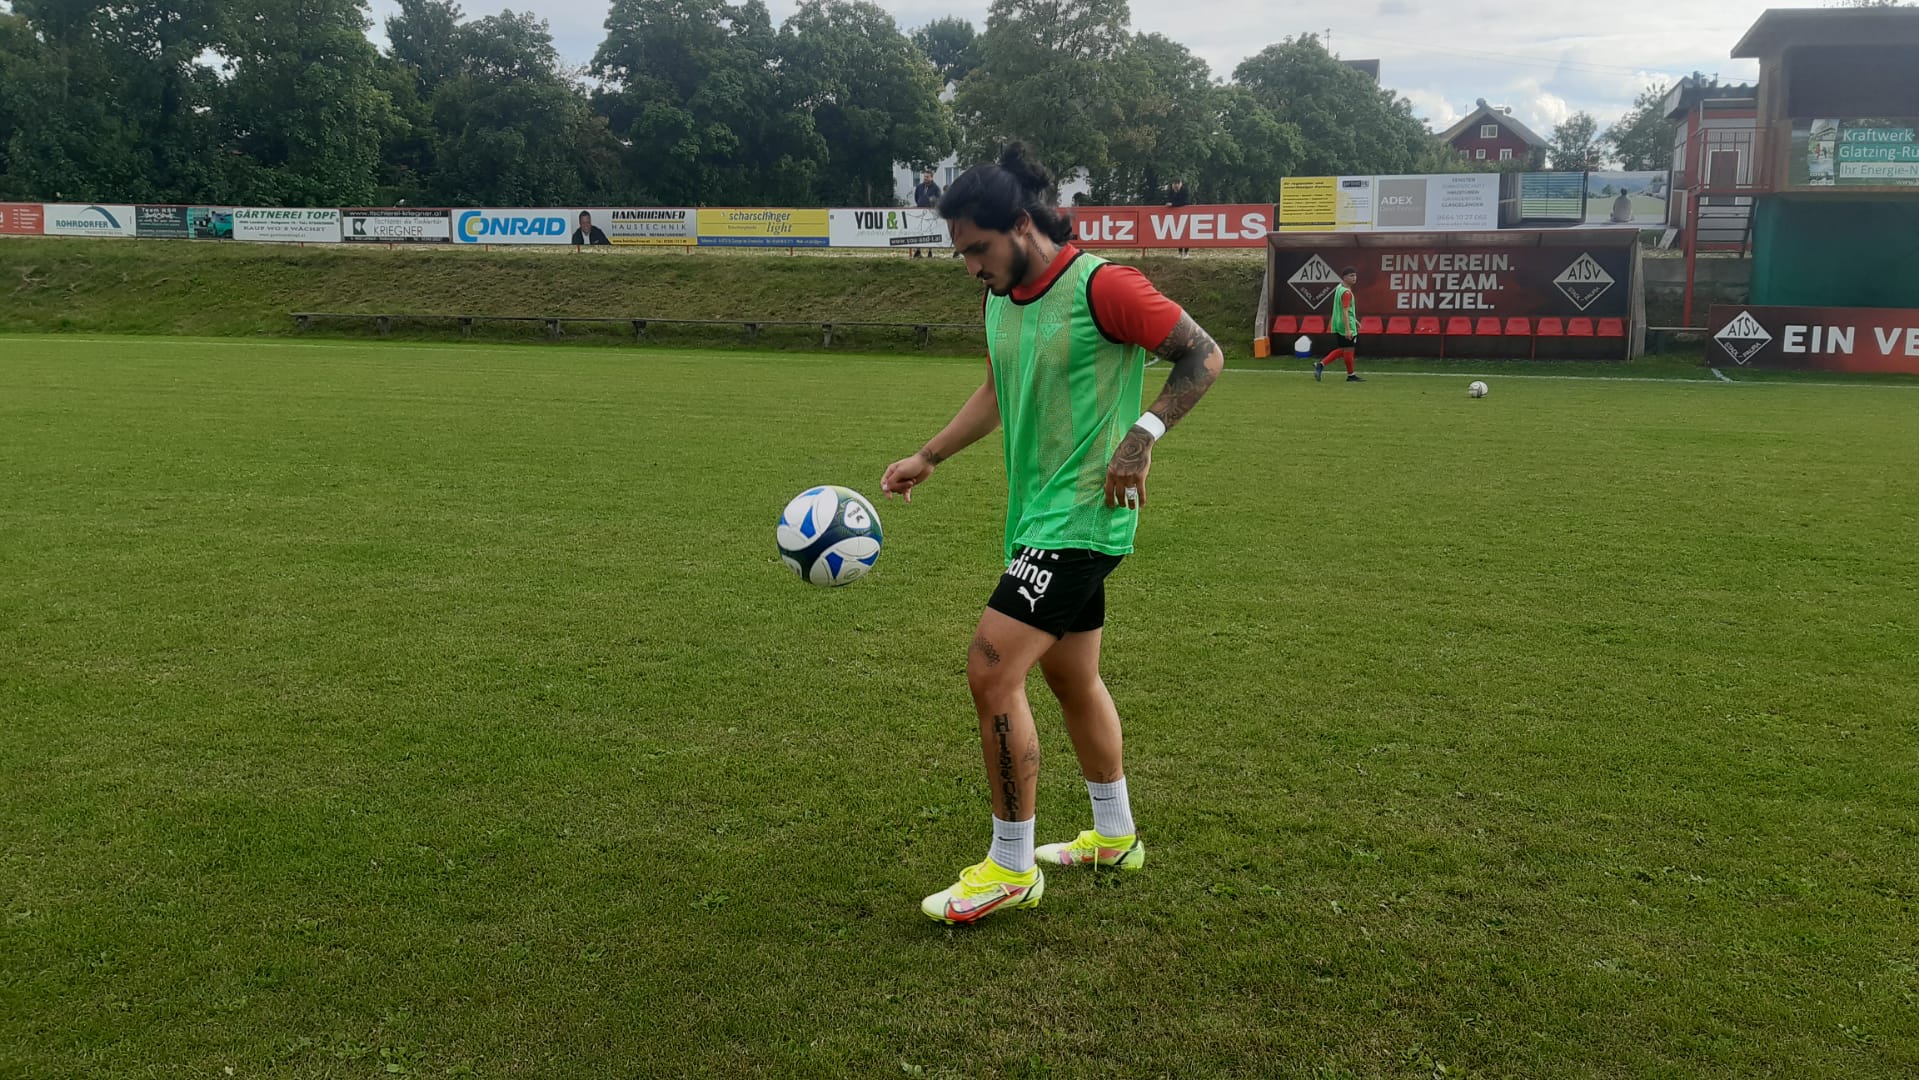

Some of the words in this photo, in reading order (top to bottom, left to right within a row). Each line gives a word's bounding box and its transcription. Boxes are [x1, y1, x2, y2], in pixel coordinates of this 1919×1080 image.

[1841, 164, 1857, 175] Ihr
[1381, 196, 1413, 205] ADEX
[235, 209, 301, 219] GÄRTNEREI
[306, 211, 337, 219] TOPF
[855, 211, 883, 229] YOU
[887, 211, 898, 229] &
[56, 219, 109, 229] ROHRDORFER
[373, 226, 424, 236] KRIEGNER
[458, 210, 566, 242] CONRAD
[767, 222, 793, 235] light
[1079, 215, 1134, 241] utz
[1150, 213, 1267, 240] WELS
[1300, 260, 1331, 280] ATSV
[1381, 254, 1419, 271] EIN
[1423, 254, 1515, 271] VEREIN.
[1567, 259, 1601, 280] ATSV
[1390, 273, 1428, 290] EIN
[1432, 273, 1504, 290] TEAM.
[1397, 292, 1434, 309] EIN
[1438, 292, 1495, 309] ZIEL.
[1727, 316, 1760, 336] ATSV
[1783, 325, 1855, 354] EIN
[1874, 327, 1919, 356] VE
[1005, 554, 1053, 594] ding
